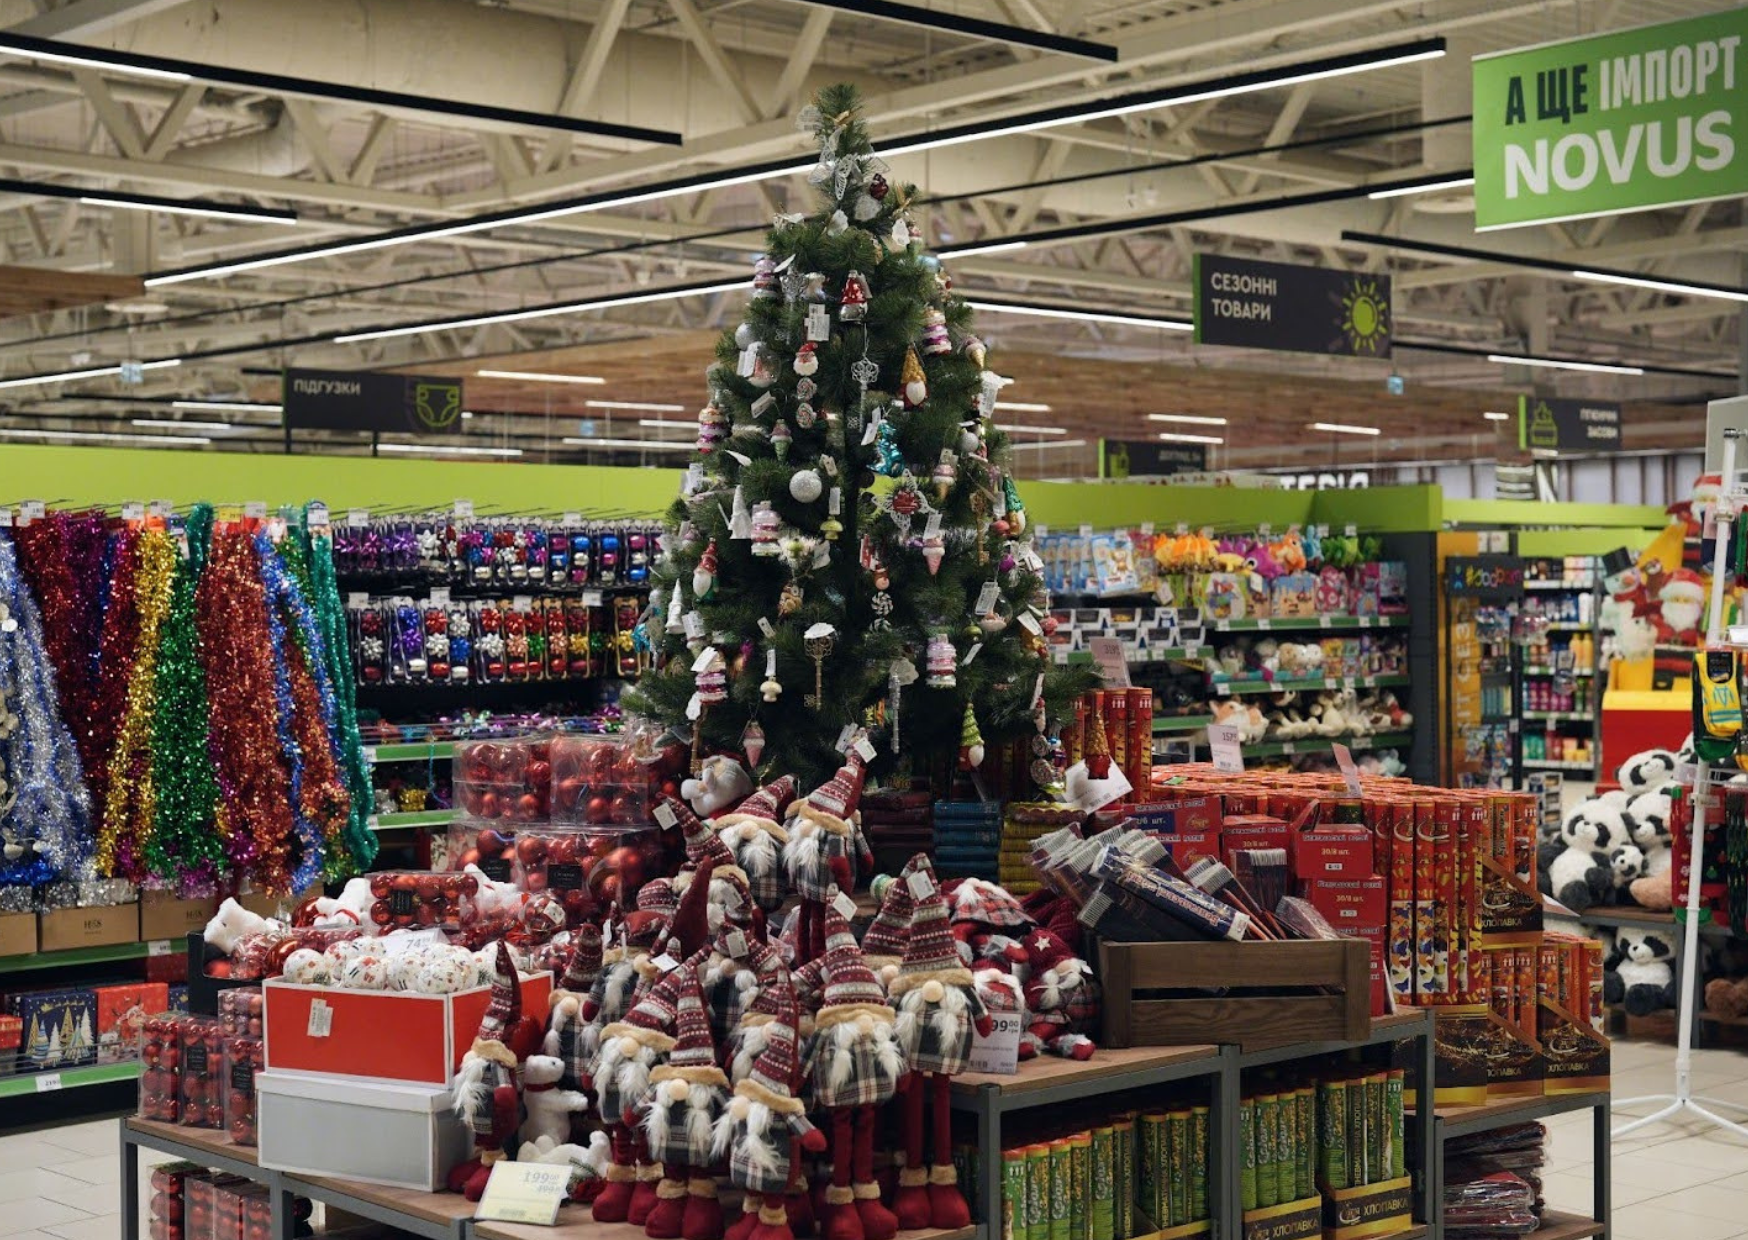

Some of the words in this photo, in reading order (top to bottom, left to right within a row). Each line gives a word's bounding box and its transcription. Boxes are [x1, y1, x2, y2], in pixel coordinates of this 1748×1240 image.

[1505, 76, 1526, 126] А
[1537, 63, 1589, 125] ЩЕ
[1600, 35, 1741, 111] ІМПОРТ
[1504, 110, 1736, 199] NOVUS
[1210, 272, 1277, 296] СЕЗОННІ
[1211, 298, 1271, 322] ТОВАРИ
[293, 378, 361, 396] ПІДГУЗКИ
[1548, 1062, 1590, 1073] ХЛОПАВКА
[1364, 1198, 1408, 1216] ХЛОПАВКА
[1272, 1219, 1319, 1239] ХЛОПАВКА
